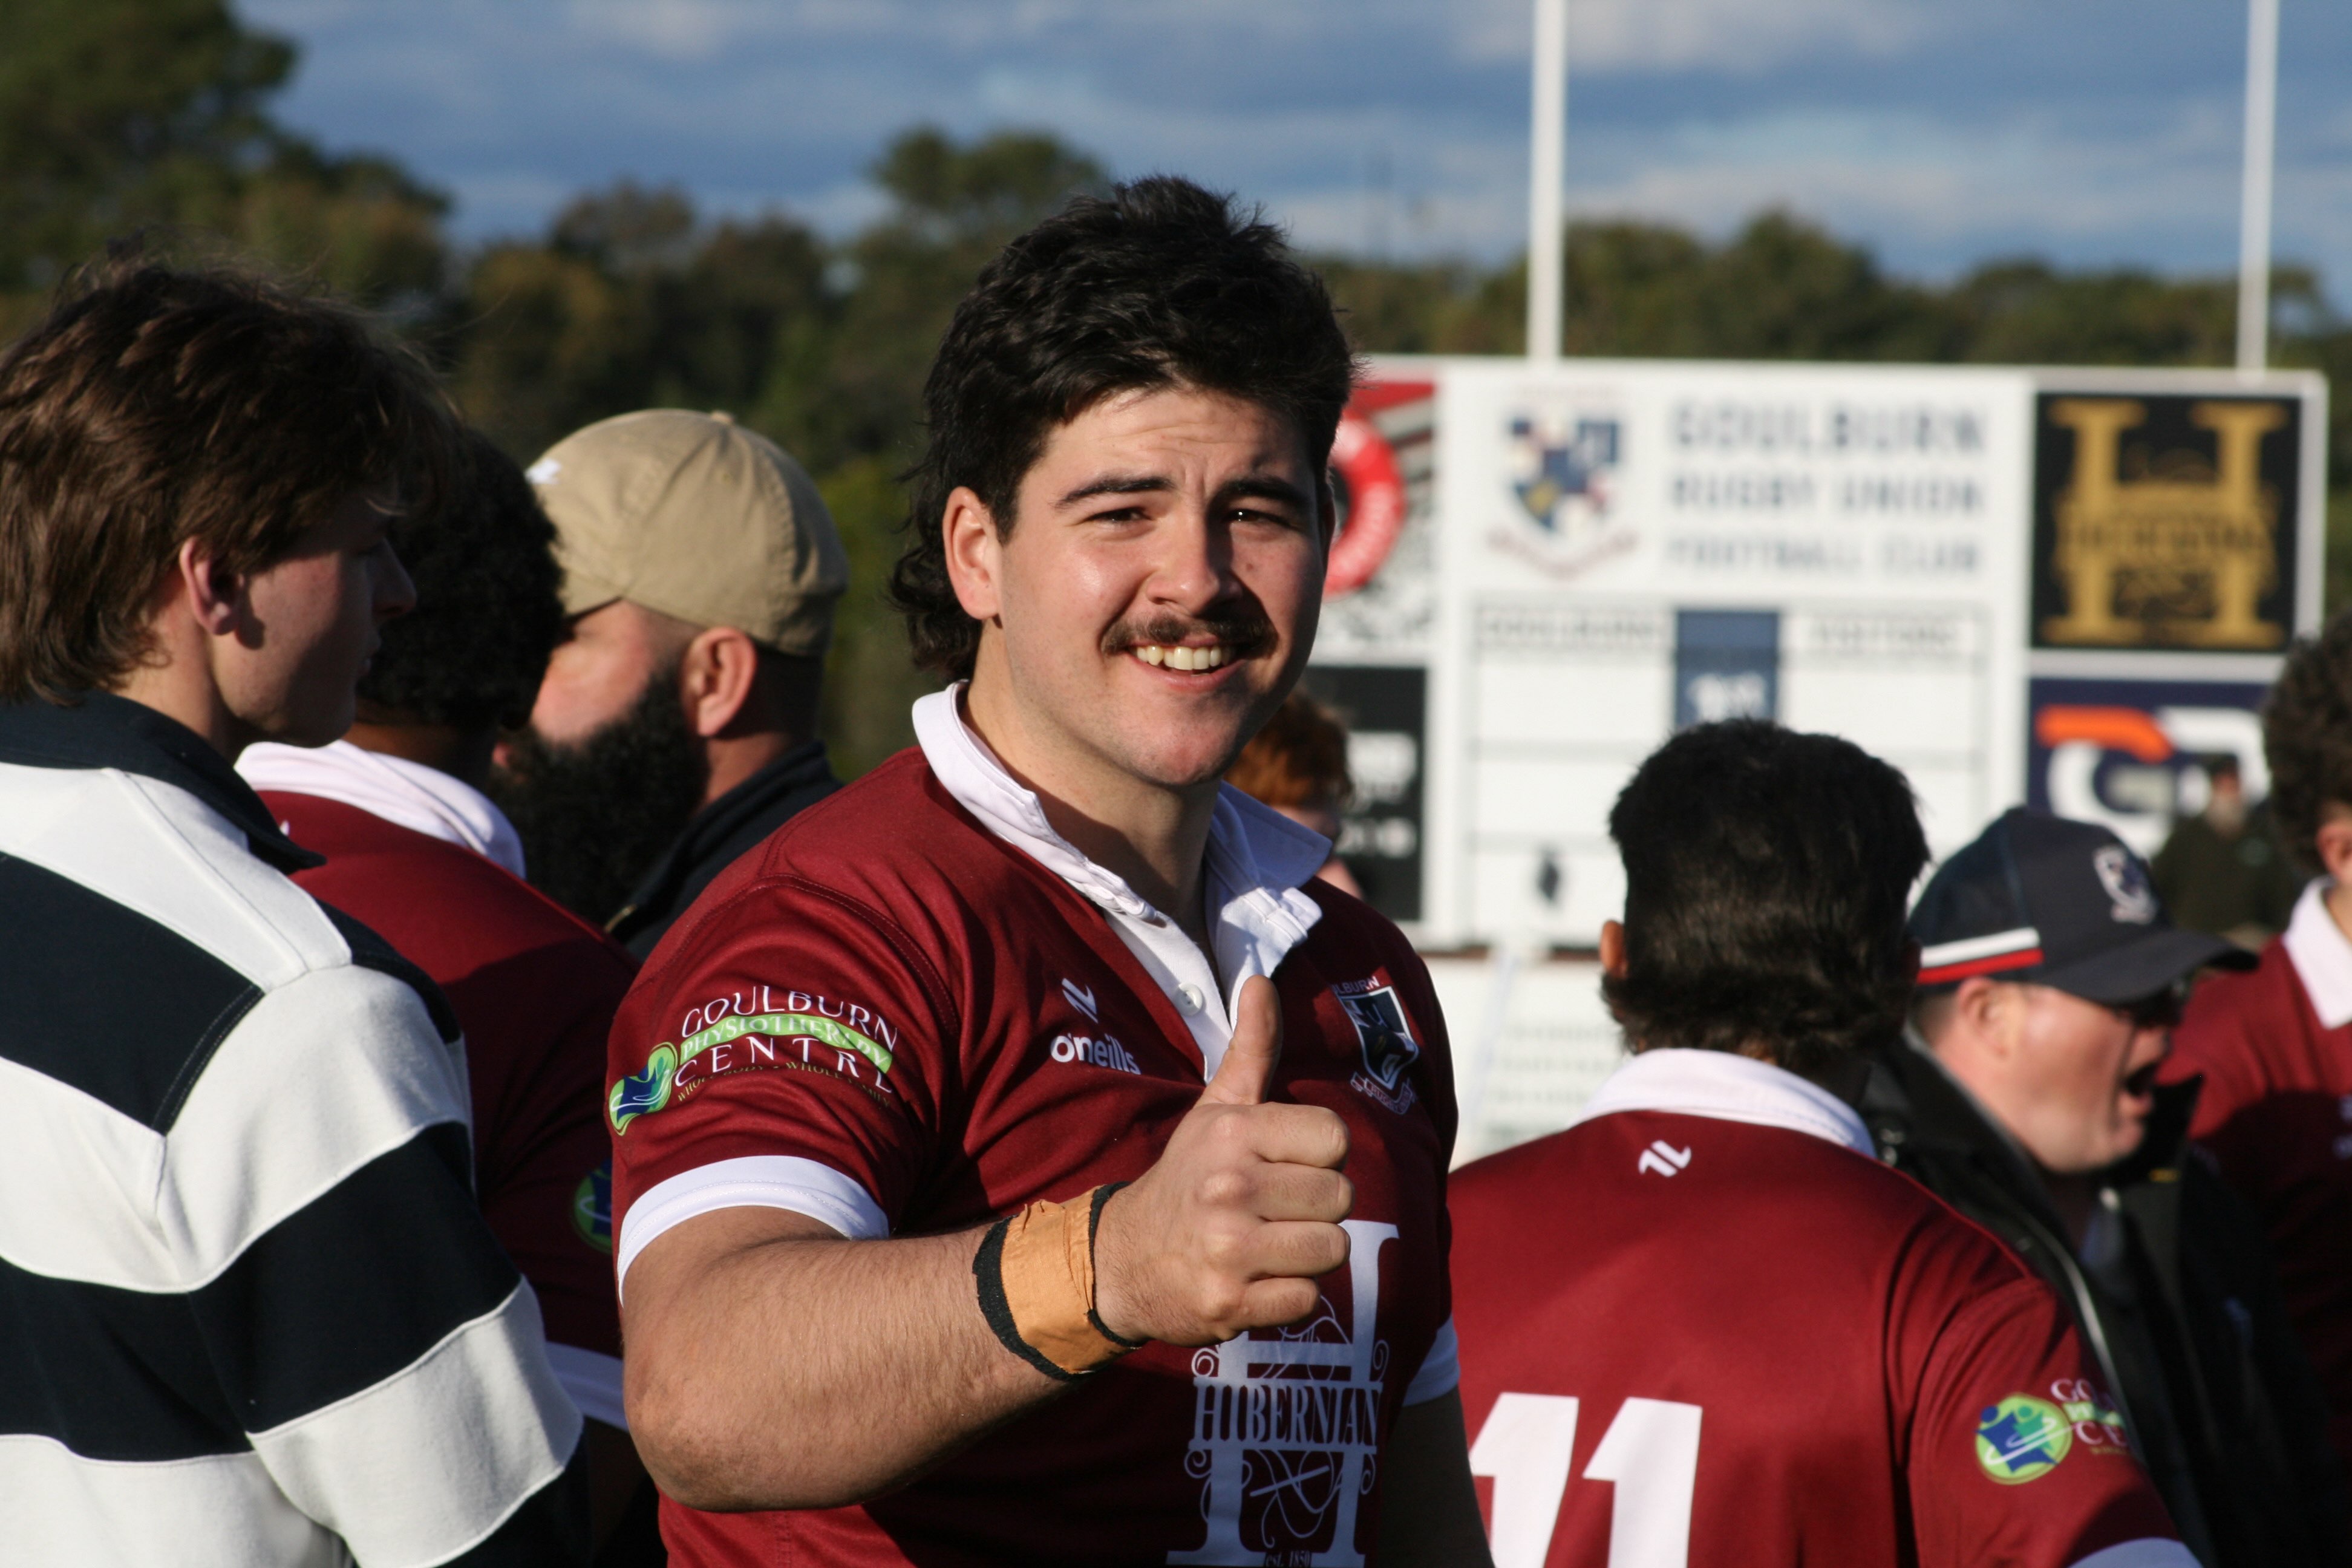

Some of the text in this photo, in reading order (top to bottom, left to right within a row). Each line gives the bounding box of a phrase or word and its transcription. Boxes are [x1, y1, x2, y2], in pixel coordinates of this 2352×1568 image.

[682, 985, 898, 1052] GOULBURN
[1190, 1380, 1382, 1449] HIBERNIAN
[1468, 1392, 1703, 1568] 11
